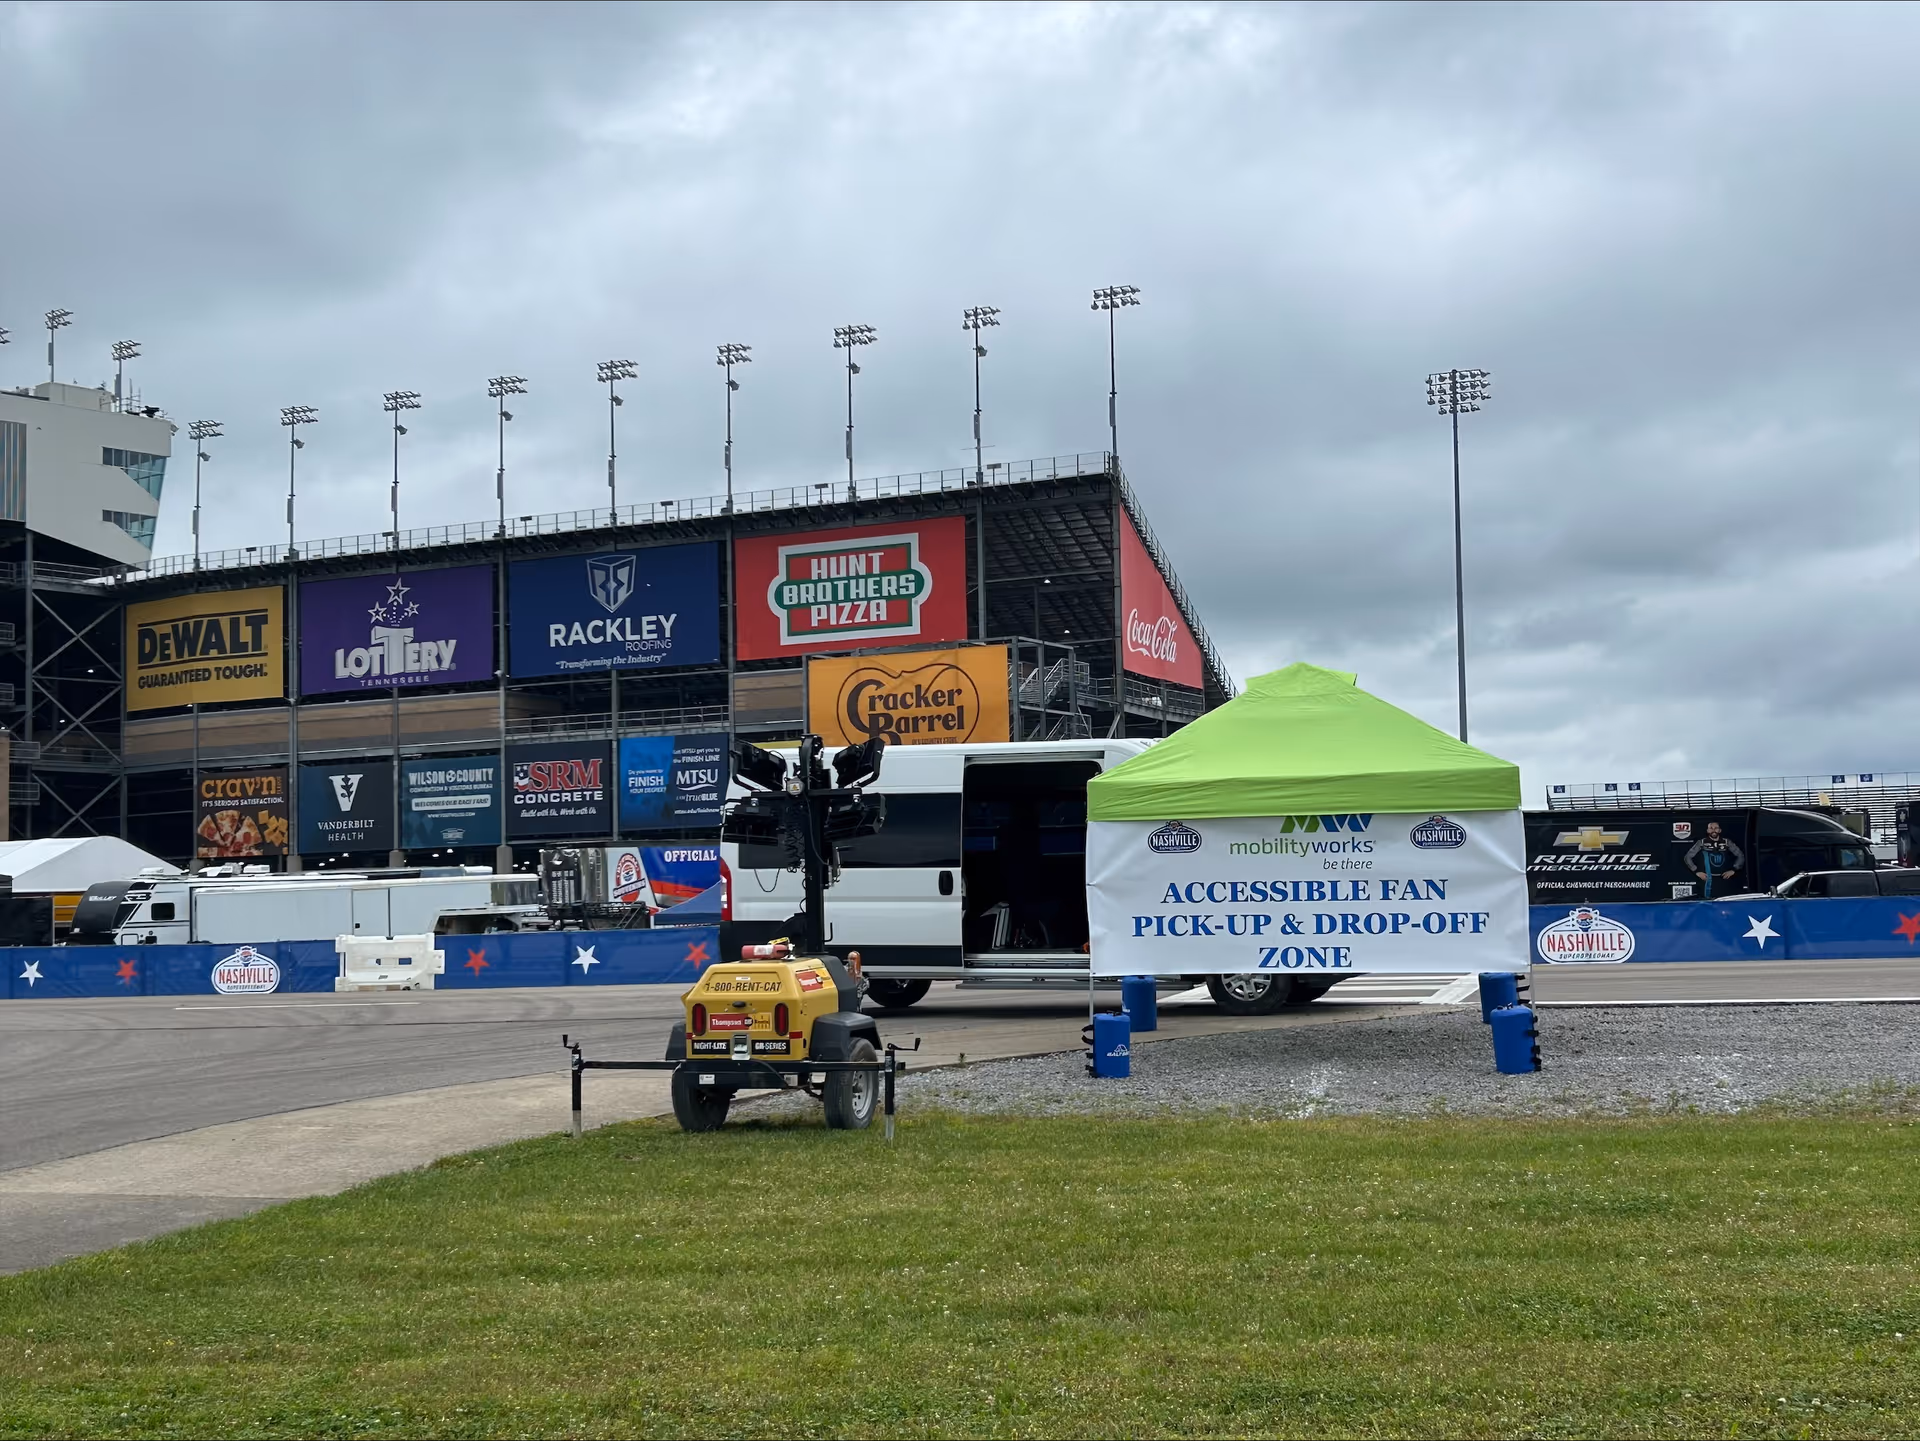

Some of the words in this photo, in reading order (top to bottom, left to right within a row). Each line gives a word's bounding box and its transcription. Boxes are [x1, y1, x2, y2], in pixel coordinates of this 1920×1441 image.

[810, 552, 885, 581] HUNT
[783, 573, 915, 606] BROTHERS
[811, 599, 887, 627] PIZZA
[549, 613, 677, 647] RACKLEY
[335, 625, 457, 679] LOTTERY
[625, 639, 672, 652] ROOFING
[612, 656, 627, 666] the
[138, 668, 211, 689] GUARANTEED
[214, 663, 268, 681] TOUGH.
[360, 675, 430, 687] TENNESSEE
[847, 679, 962, 733] Cracker
[868, 705, 965, 745] Barrel
[682, 755, 704, 763] FINISH
[705, 754, 720, 762] LINE
[408, 770, 445, 786] WILSON
[456, 768, 494, 783] COUNTY
[529, 758, 603, 792] SRM
[628, 775, 664, 787] FINISH
[676, 769, 718, 785] MTSU
[219, 799, 244, 807] SERIOUS
[514, 791, 603, 804] CONCRETE
[317, 819, 374, 830] VANDERBILT
[328, 832, 364, 841] HEALTH
[1152, 834, 1198, 847] NASHVILLE
[1415, 830, 1461, 842] NASHVILLE
[1230, 837, 1373, 858] mobilityworks
[664, 850, 717, 862] OFFICIAL
[1533, 853, 1652, 864] RACING
[1323, 858, 1338, 870] be
[1341, 858, 1373, 870] there
[1527, 863, 1660, 871] MERCHANDISE
[1160, 880, 1371, 903] ACCESSIBLE
[1379, 879, 1449, 901] FAN
[1536, 881, 1565, 889] OFFICIAL
[1131, 914, 1272, 937] PICK-UP
[1280, 913, 1305, 935] &
[1312, 911, 1490, 935] DROP-OFF
[1547, 933, 1626, 952] NASHVILLE
[1258, 946, 1352, 968] ZONE
[218, 967, 274, 984] NASHVILLE
[706, 981, 782, 992] 1-800-RENT-CAT
[711, 1018, 742, 1027] Thompson
[694, 1042, 727, 1050] NIGHT-LITE
